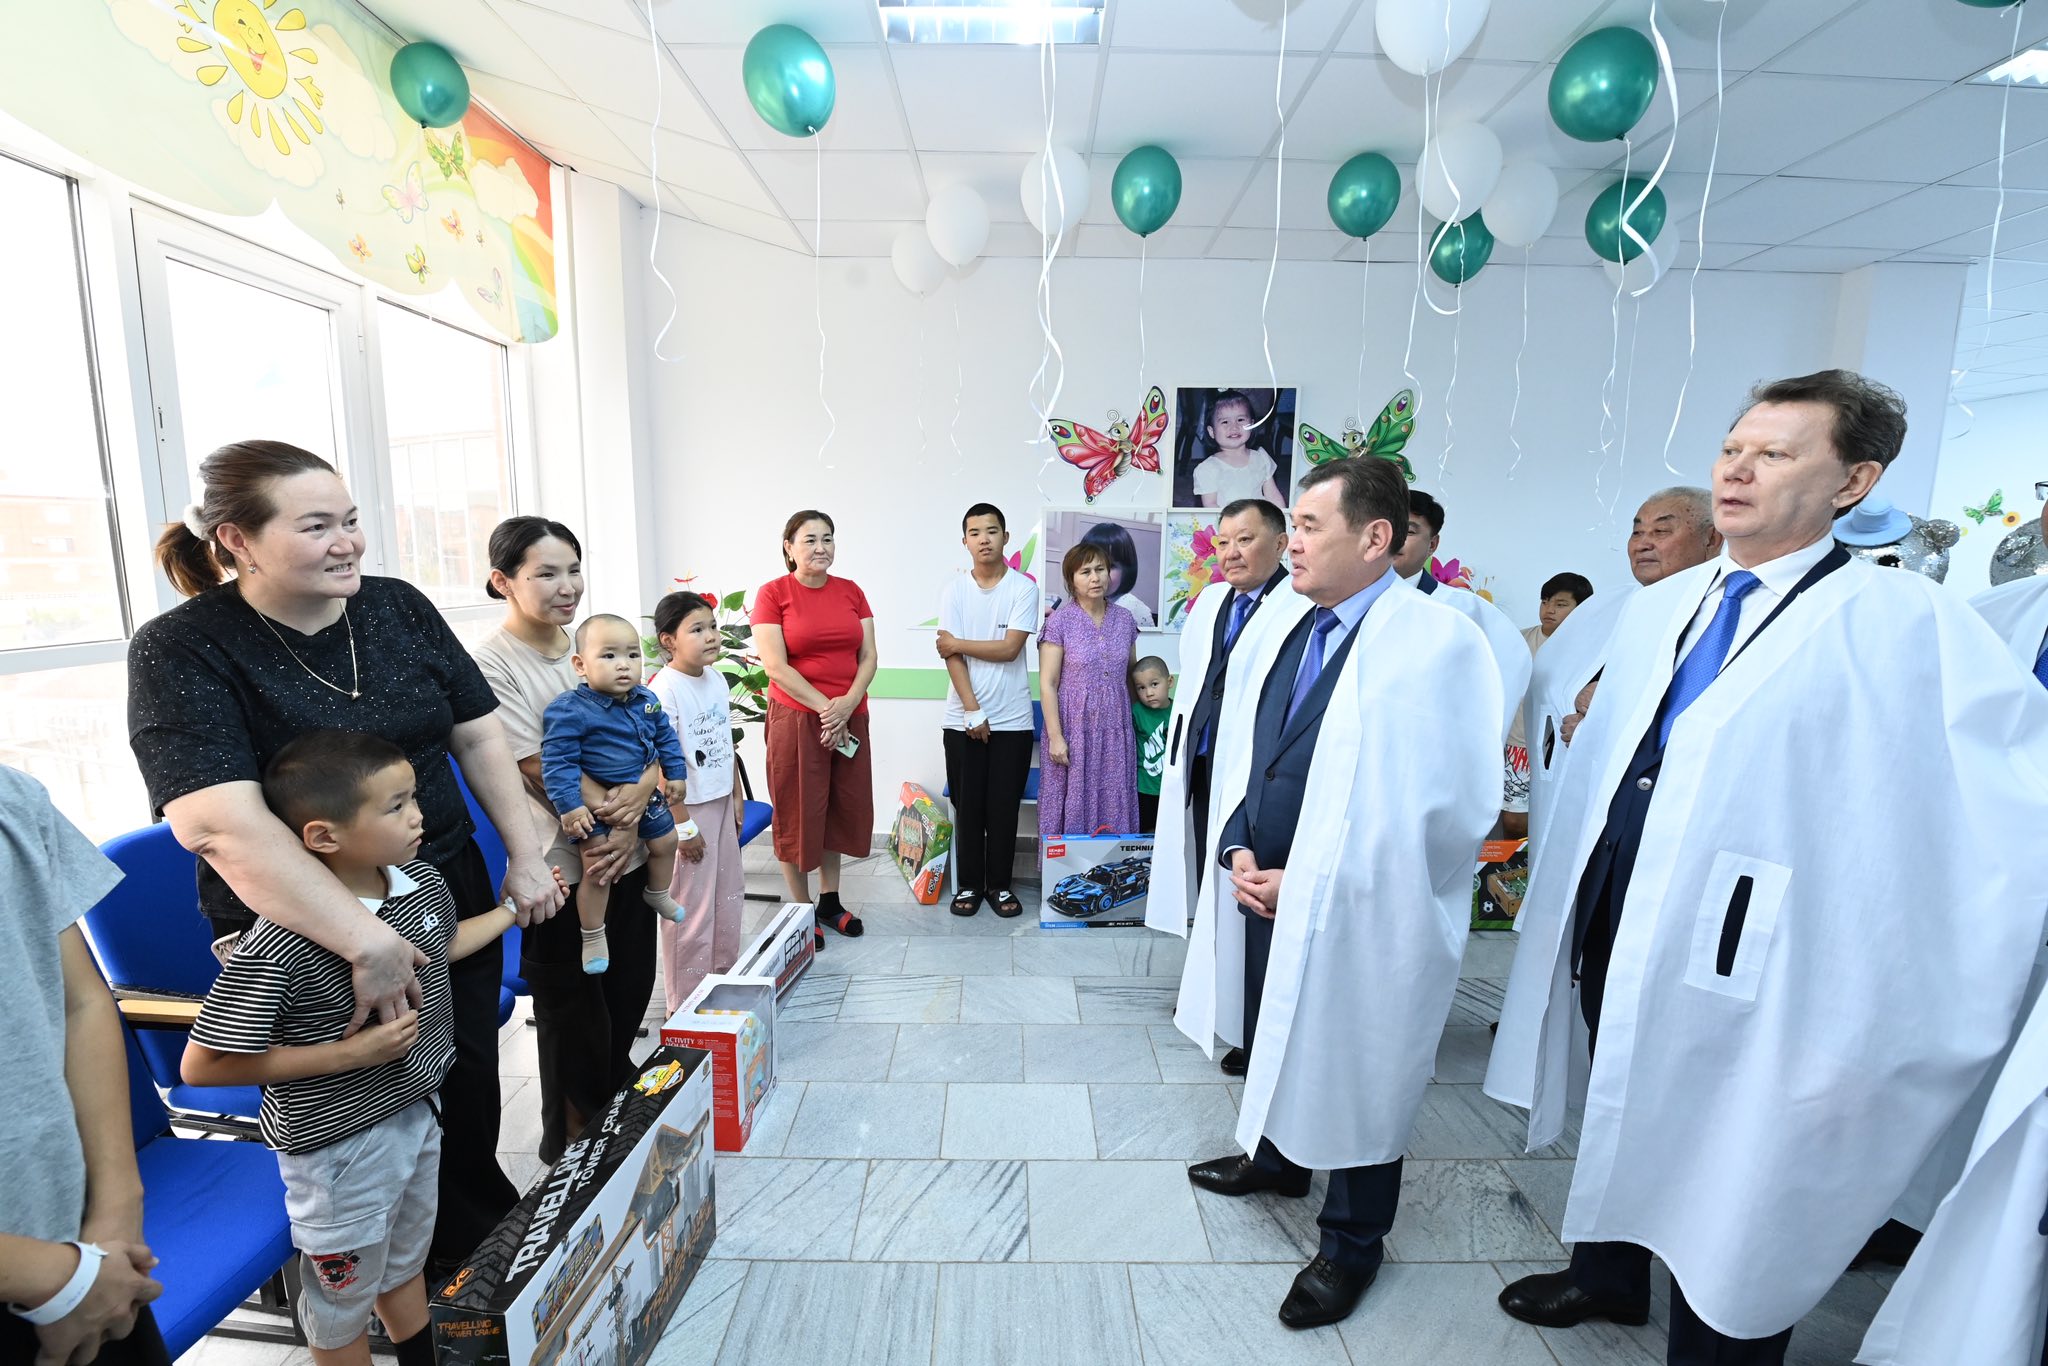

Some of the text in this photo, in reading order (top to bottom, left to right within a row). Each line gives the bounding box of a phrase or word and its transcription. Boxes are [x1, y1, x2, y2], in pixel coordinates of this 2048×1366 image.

[1143, 720, 1165, 761] NIK
[664, 1036, 695, 1045] ACTIVITY
[575, 1089, 629, 1192] TOWER CRANE
[505, 1138, 591, 1283] TRAVELLING
[447, 1329, 472, 1338] TOWER
